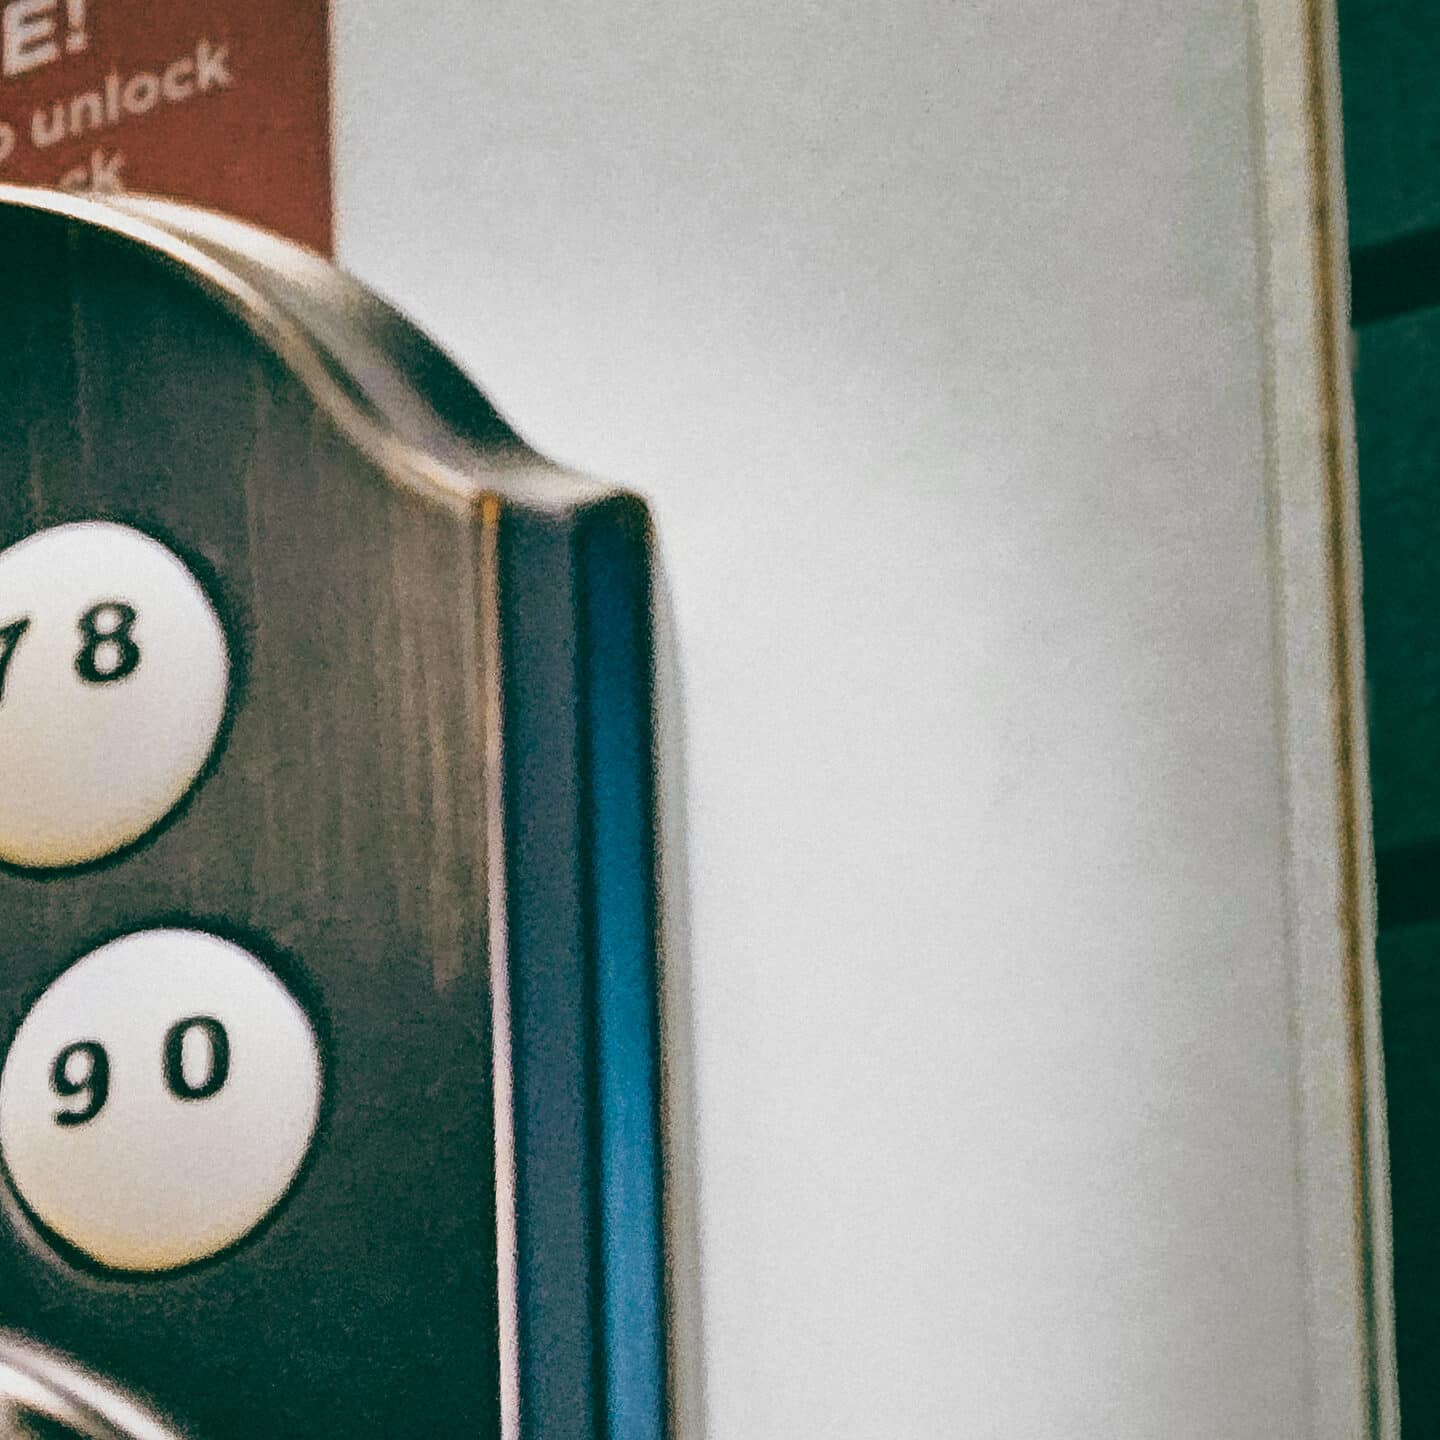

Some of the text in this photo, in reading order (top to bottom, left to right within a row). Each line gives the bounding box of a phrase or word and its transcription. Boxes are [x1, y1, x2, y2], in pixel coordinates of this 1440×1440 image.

[31, 39, 232, 149] unlock
[74, 600, 141, 683] 8
[53, 1014, 230, 1126] 9 0
